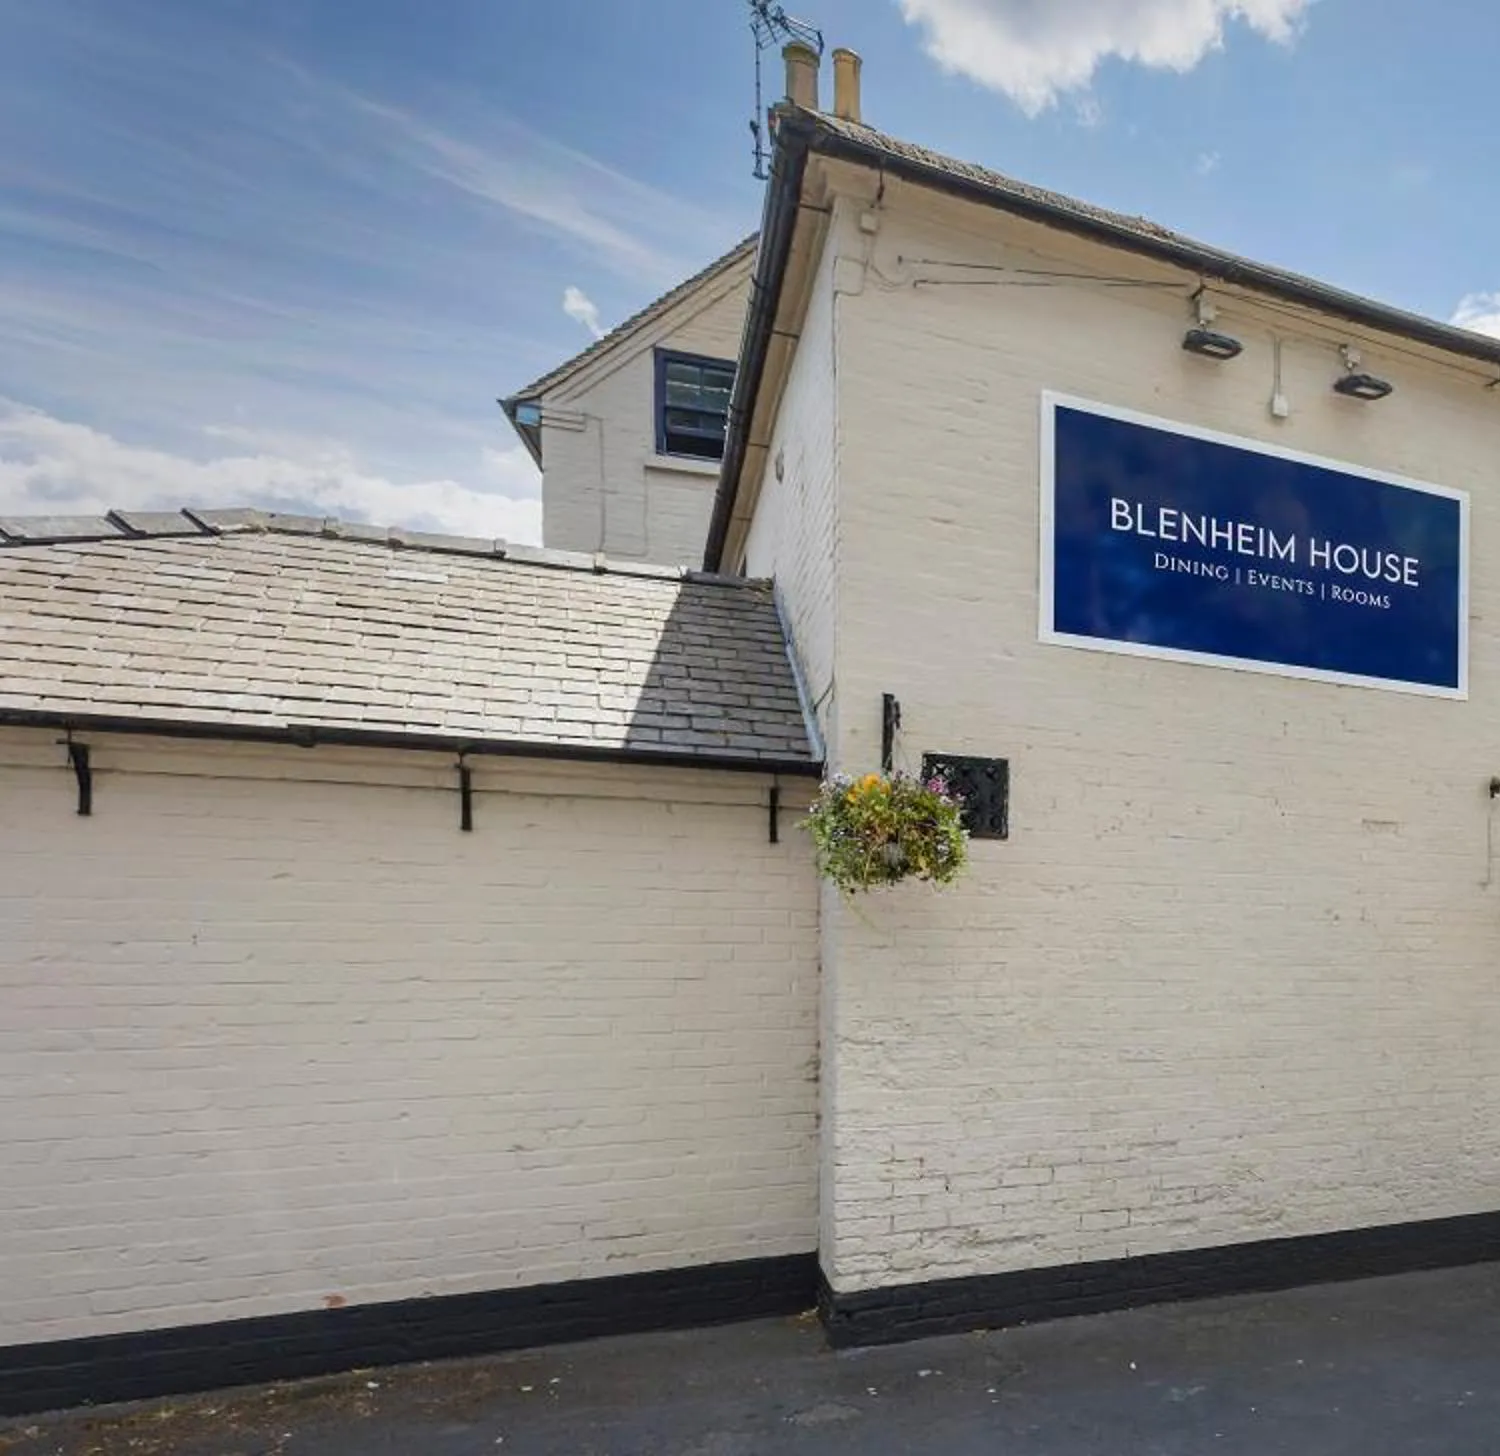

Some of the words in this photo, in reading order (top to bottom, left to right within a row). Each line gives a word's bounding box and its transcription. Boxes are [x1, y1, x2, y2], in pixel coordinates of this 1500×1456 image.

[1110, 497, 1296, 563] BLENHEIM
[1309, 536, 1420, 587] HOUSE
[1154, 552, 1230, 580] DINING
[1246, 568, 1315, 596] EVENTS
[1330, 584, 1392, 609] ROOMS
